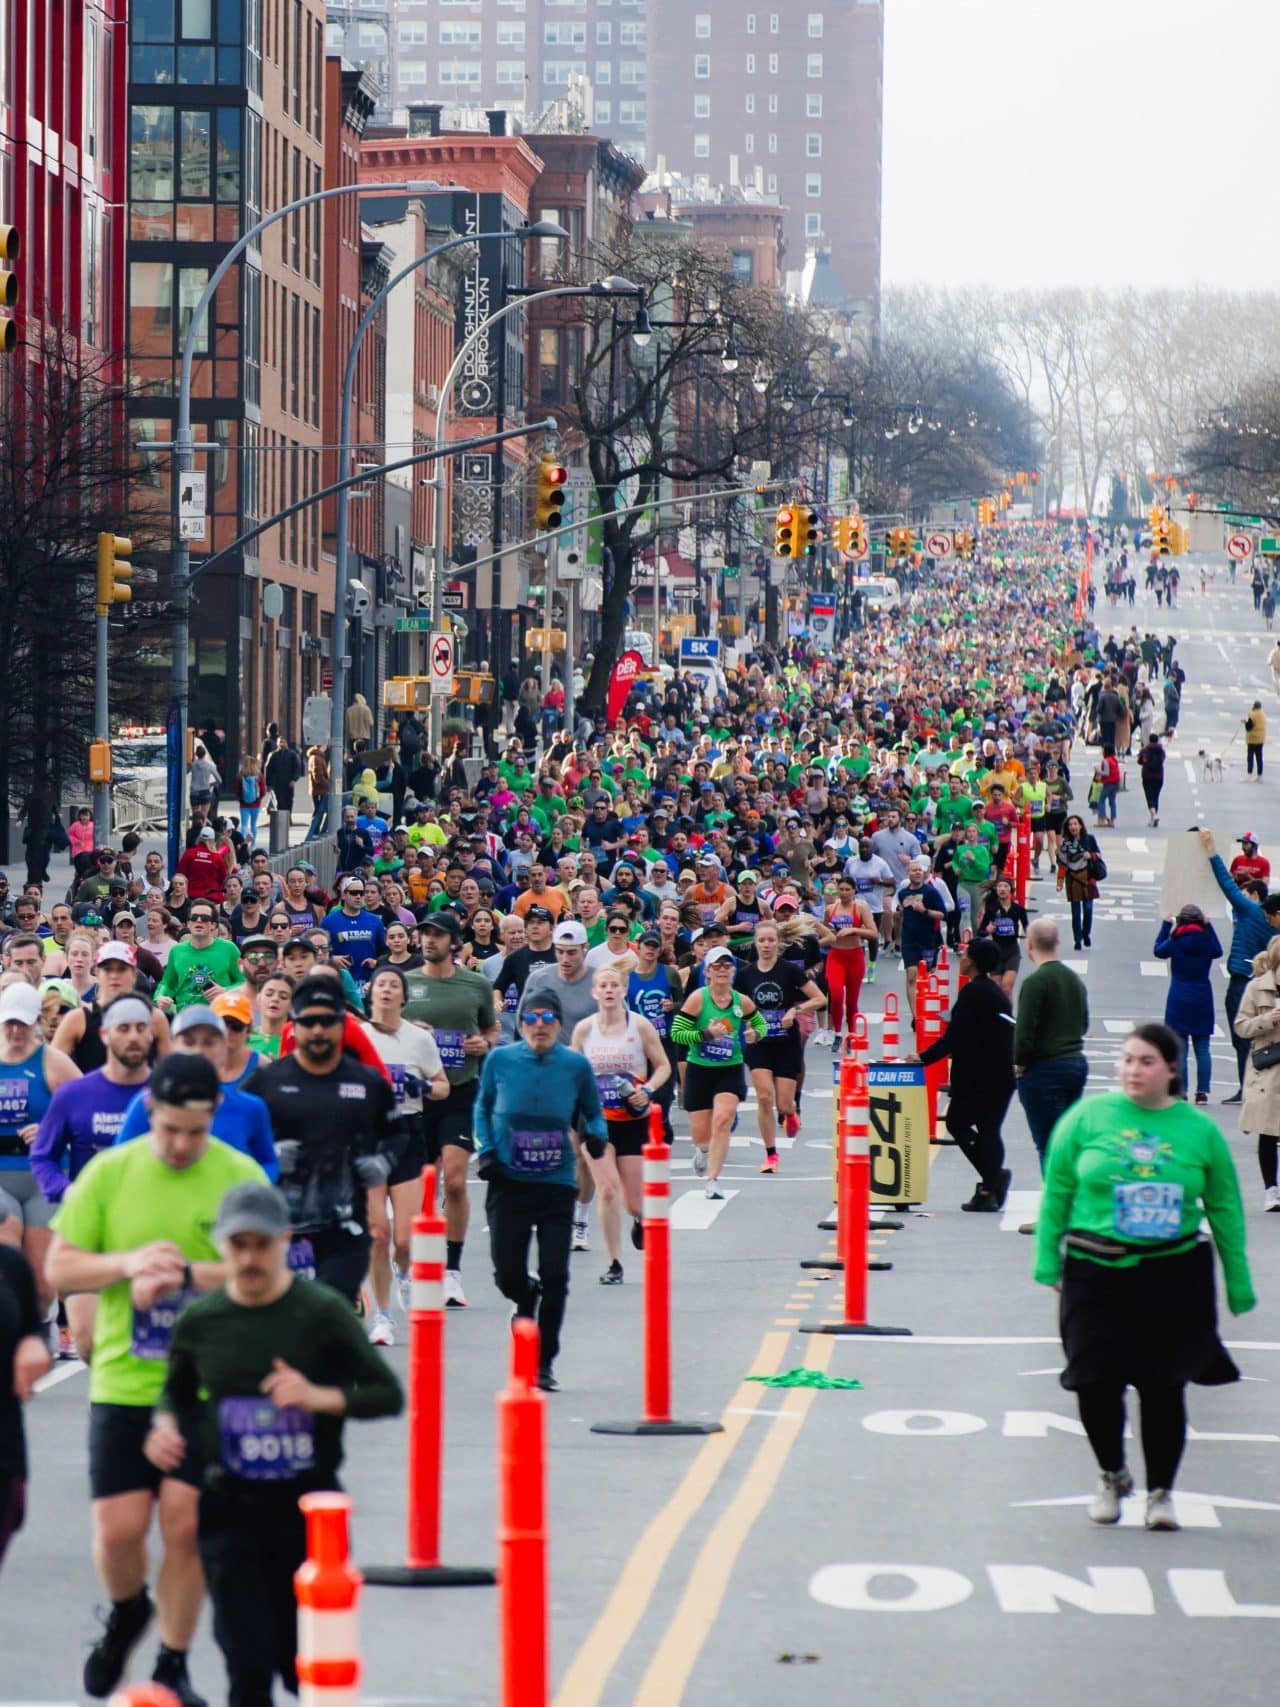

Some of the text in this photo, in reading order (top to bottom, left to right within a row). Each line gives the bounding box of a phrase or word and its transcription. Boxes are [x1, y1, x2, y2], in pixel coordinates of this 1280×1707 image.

[402, 620, 420, 630] DEAN
[691, 642, 709, 654] 5K
[876, 1071, 897, 1082] CAN
[897, 1071, 915, 1082] FEEL
[869, 1092, 903, 1197] C4
[523, 1150, 562, 1162] 12172
[904, 1144, 912, 1198] PERFORMANCE
[239, 1432, 314, 1461] 9018
[810, 1562, 1280, 1619] ONL
